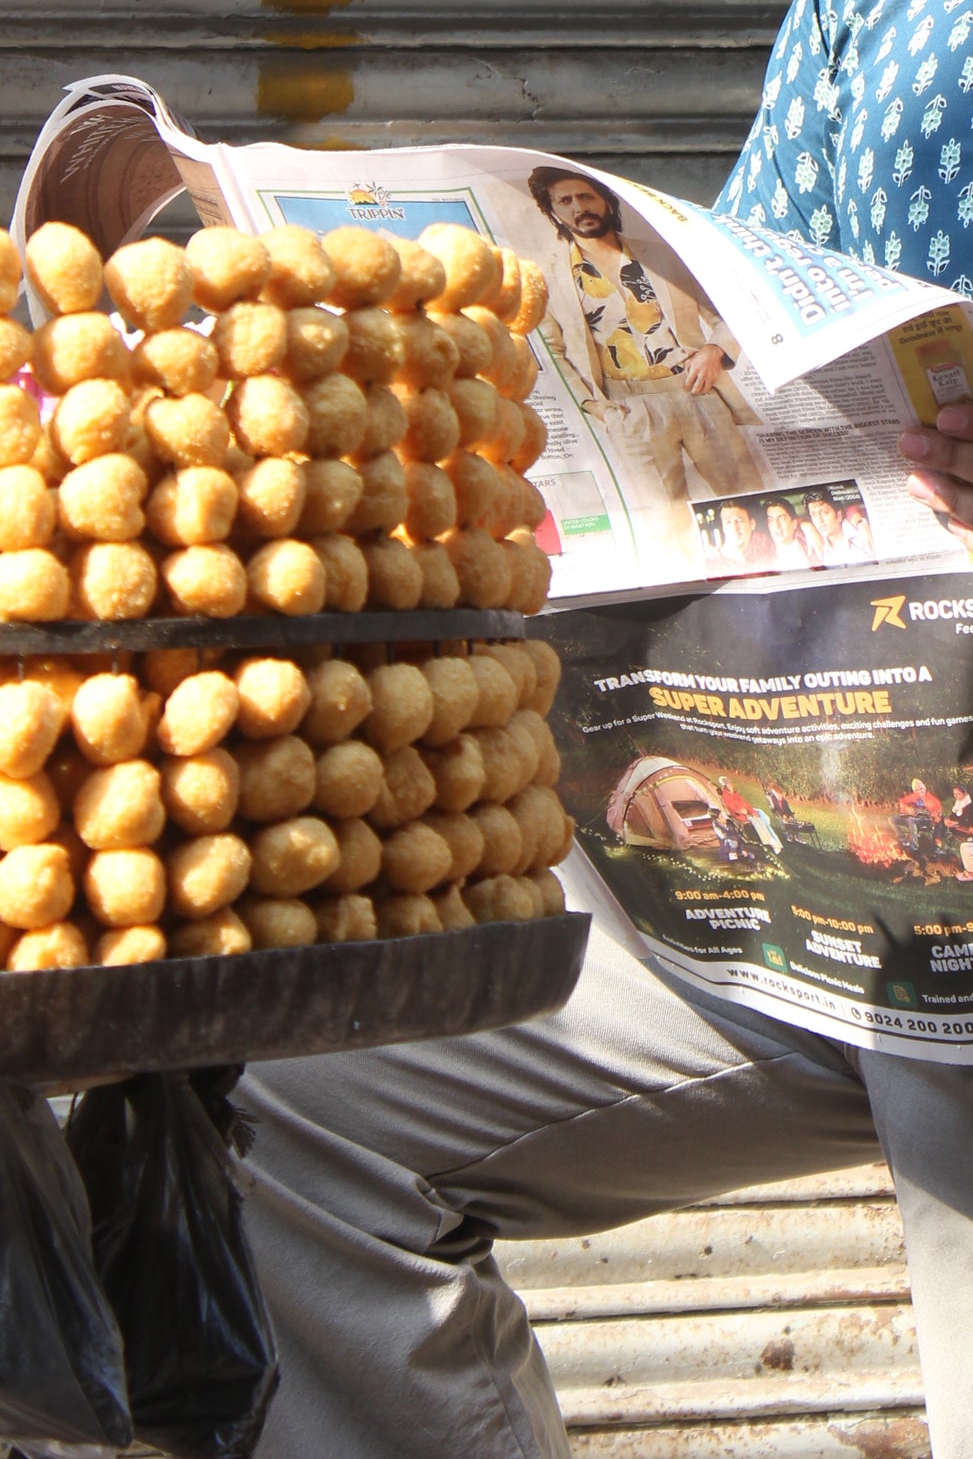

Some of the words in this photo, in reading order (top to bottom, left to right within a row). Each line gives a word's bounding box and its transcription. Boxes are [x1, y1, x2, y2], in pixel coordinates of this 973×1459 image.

[765, 254, 826, 327] Didn't
[805, 264, 852, 315] into
[837, 266, 874, 303] I'm
[771, 333, 784, 346] 8
[533, 479, 556, 489] TARS
[594, 669, 696, 692] TRANSFORM
[695, 675, 738, 693] YOUR
[739, 675, 802, 693] FAMILY
[803, 670, 871, 689] OUTING
[872, 666, 917, 685] INTO
[918, 665, 933, 682] A
[648, 686, 727, 718] SUPER
[728, 690, 893, 721] ADVENTURE
[582, 724, 602, 734] Gear
[602, 721, 614, 731] up
[613, 718, 625, 728] for
[632, 711, 656, 725] Super
[746, 725, 761, 735] soft
[761, 724, 800, 736] adventure
[841, 720, 872, 732] exciting
[872, 717, 914, 731] challenges
[915, 718, 930, 727] and
[931, 717, 945, 727] fun
[946, 715, 973, 727] games
[786, 734, 802, 743] into
[815, 732, 832, 744] epic
[833, 730, 875, 741] adventure.
[675, 890, 701, 901] 9:00
[703, 890, 748, 901] am-4:00
[750, 891, 765, 902] pm
[686, 907, 771, 924] ADVENTURE
[709, 918, 761, 931] PICNIC
[812, 913, 856, 932] pm-10:00
[858, 923, 875, 935] pm
[913, 924, 942, 936] 5:00
[708, 946, 721, 955] All
[722, 946, 744, 956] Ages
[811, 930, 862, 954] SUNSET
[805, 939, 883, 969] ADVENTURE
[726, 968, 836, 1011] www.rocksport.in
[922, 993, 957, 1005] Trained
[865, 1012, 903, 1029] 9024
[907, 1018, 937, 1033] 200
